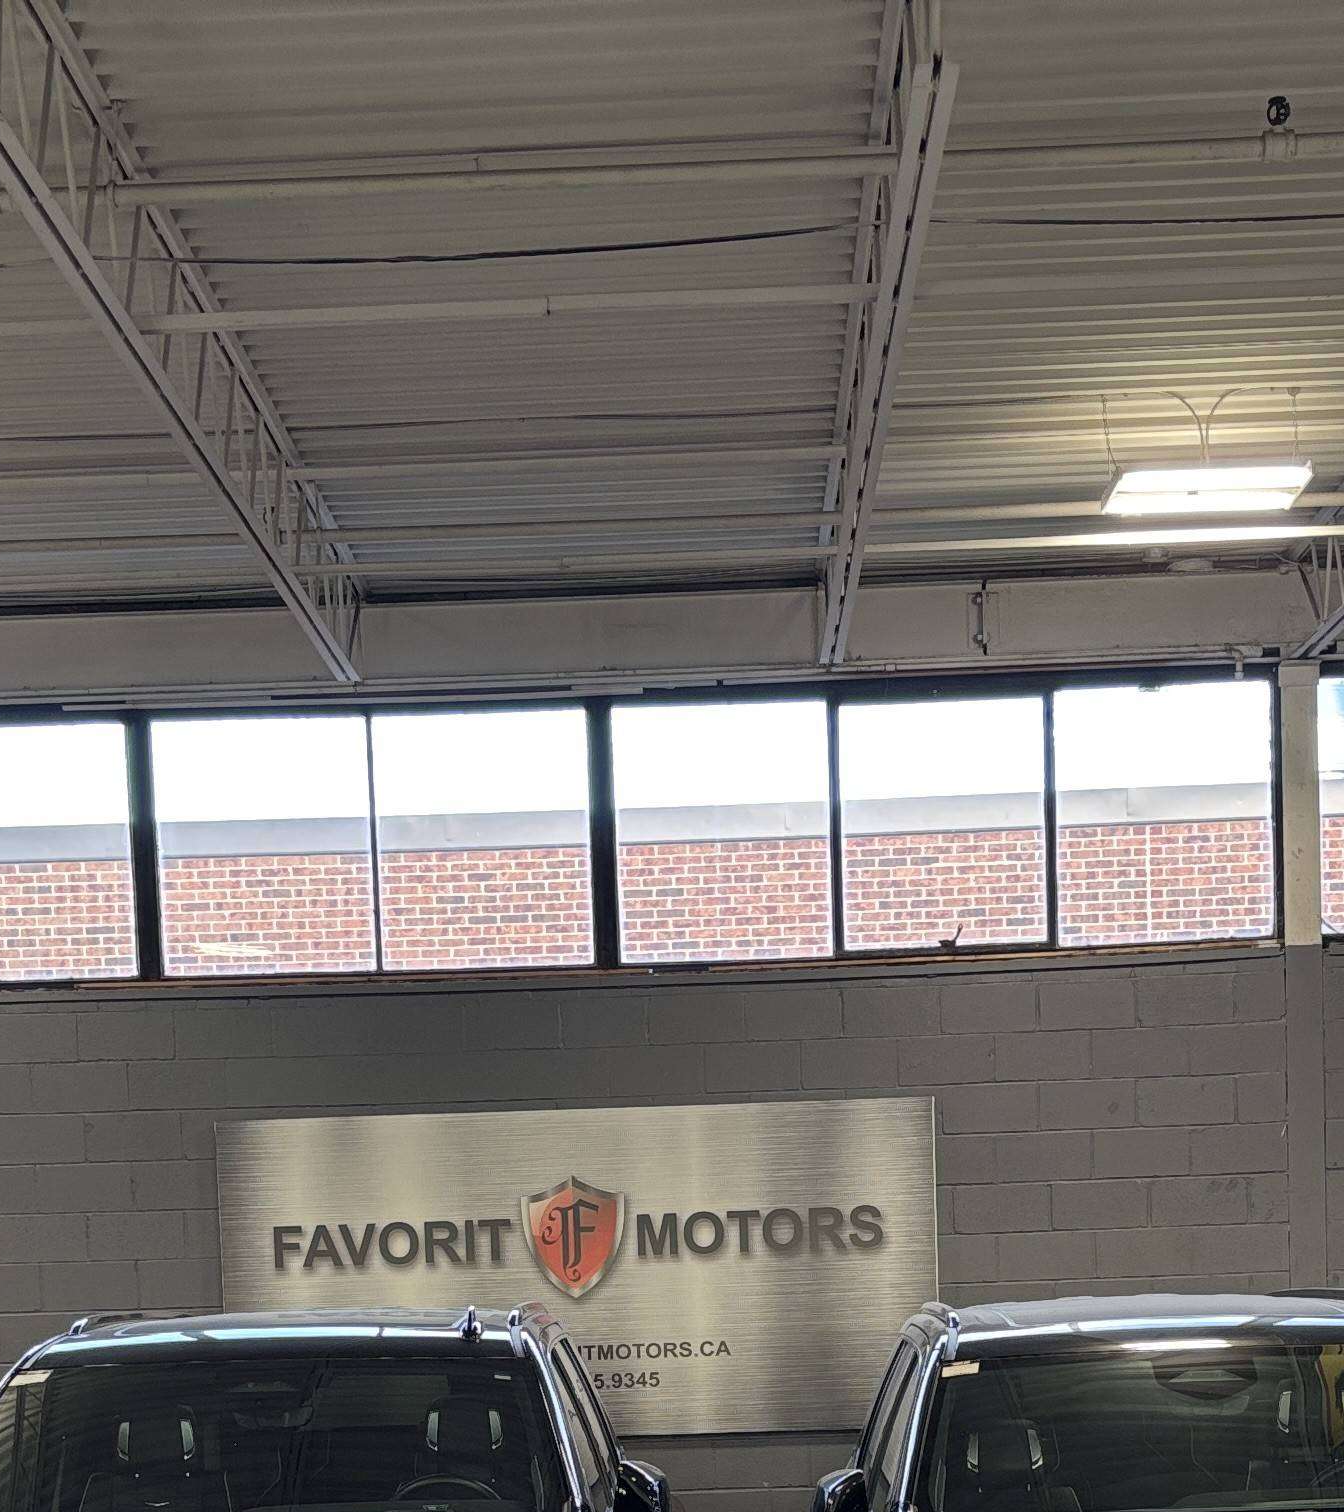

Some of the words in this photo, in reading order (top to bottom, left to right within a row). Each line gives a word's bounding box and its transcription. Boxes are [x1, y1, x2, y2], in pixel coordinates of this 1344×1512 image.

[273, 1219, 511, 1268] FAVORIT
[636, 1204, 885, 1257] MOTORS
[593, 1371, 660, 1389] 5.9345
